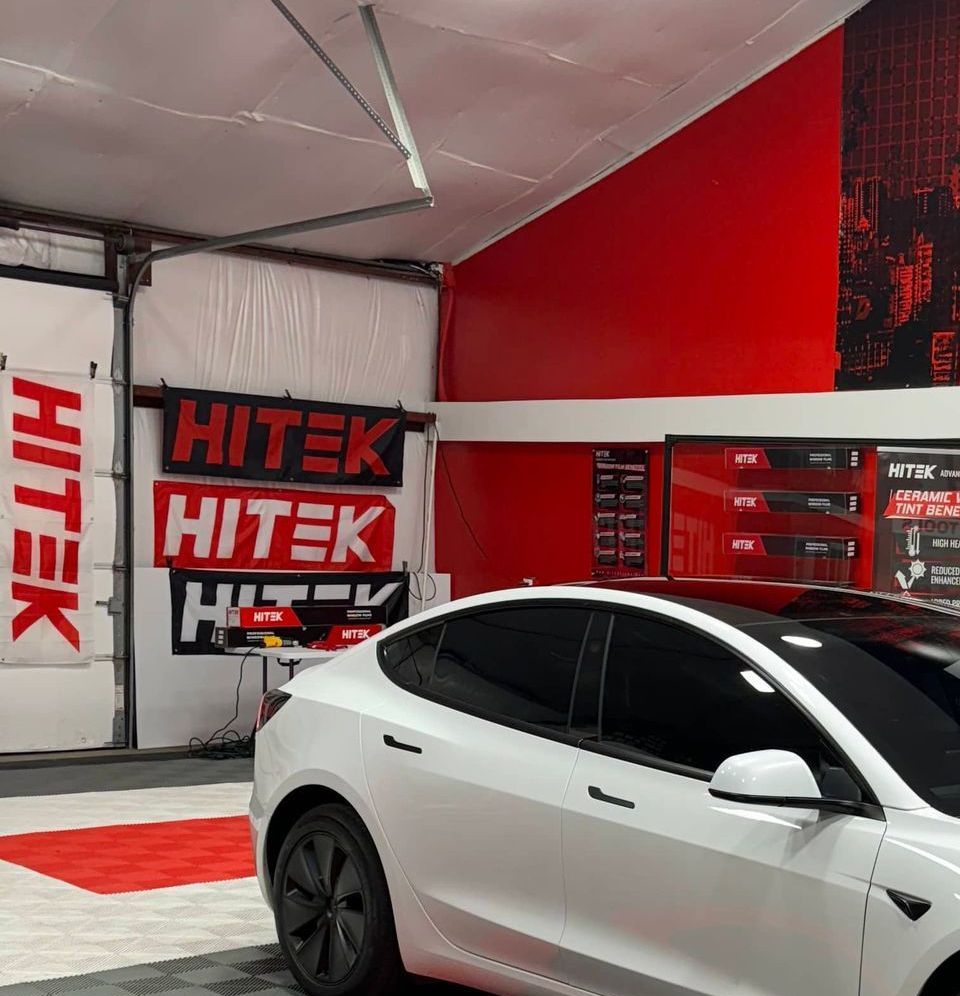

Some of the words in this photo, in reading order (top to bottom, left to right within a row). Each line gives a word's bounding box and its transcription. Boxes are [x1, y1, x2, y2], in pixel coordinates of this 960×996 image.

[172, 399, 399, 476] HITEK
[735, 453, 758, 464] HITEK
[888, 463, 937, 479] HITEK
[734, 496, 757, 507] HITEK
[895, 490, 951, 503] CERAMIC
[895, 503, 925, 515] TINT
[12, 377, 81, 653] HITEK
[163, 494, 386, 562] HITEK
[732, 539, 755, 550] HITEK
[932, 538, 949, 548] HIGH
[931, 565, 960, 576] REDUCED
[253, 611, 284, 622] HITEK
[342, 629, 371, 640] HITEK
